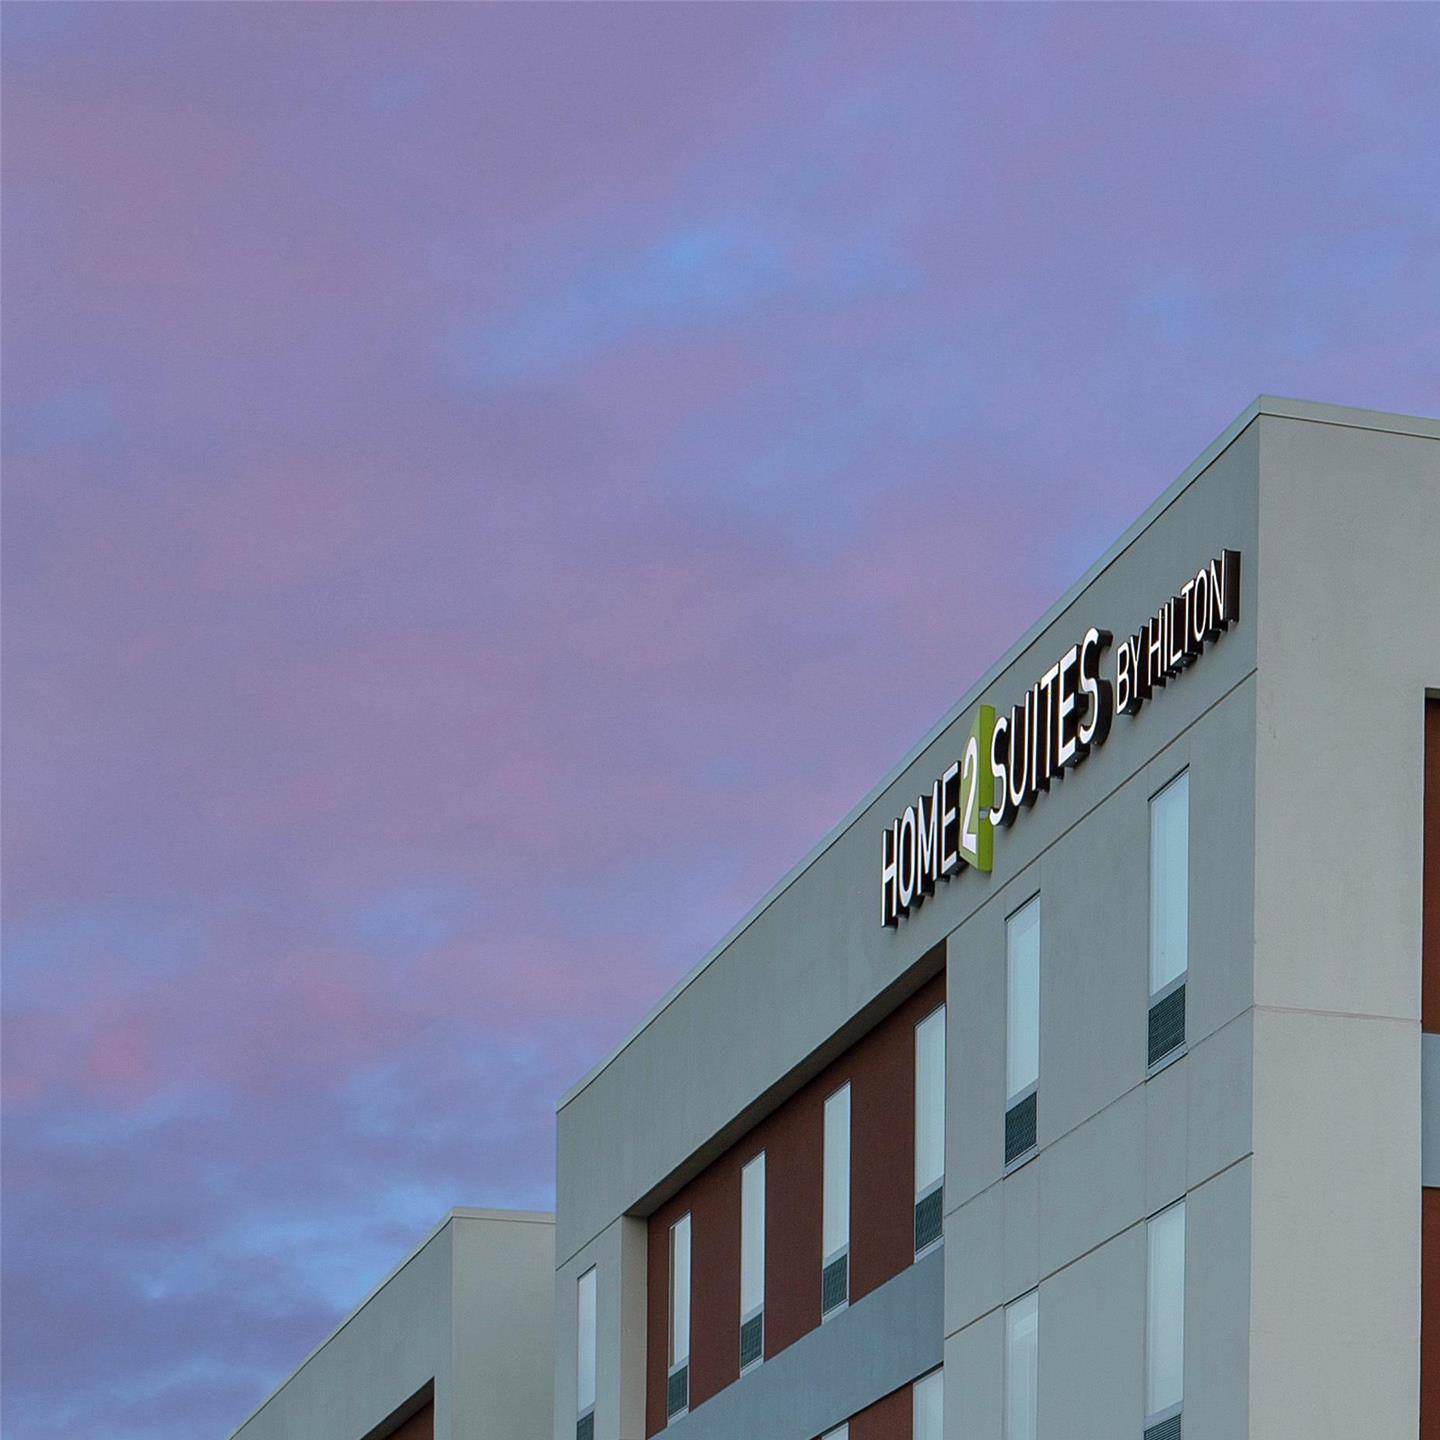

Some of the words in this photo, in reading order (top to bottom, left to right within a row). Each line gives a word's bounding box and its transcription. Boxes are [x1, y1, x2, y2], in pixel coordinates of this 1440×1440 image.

[989, 627, 1113, 828] SUITES
[1117, 625, 1152, 715] BY
[1148, 549, 1241, 687] HILTON
